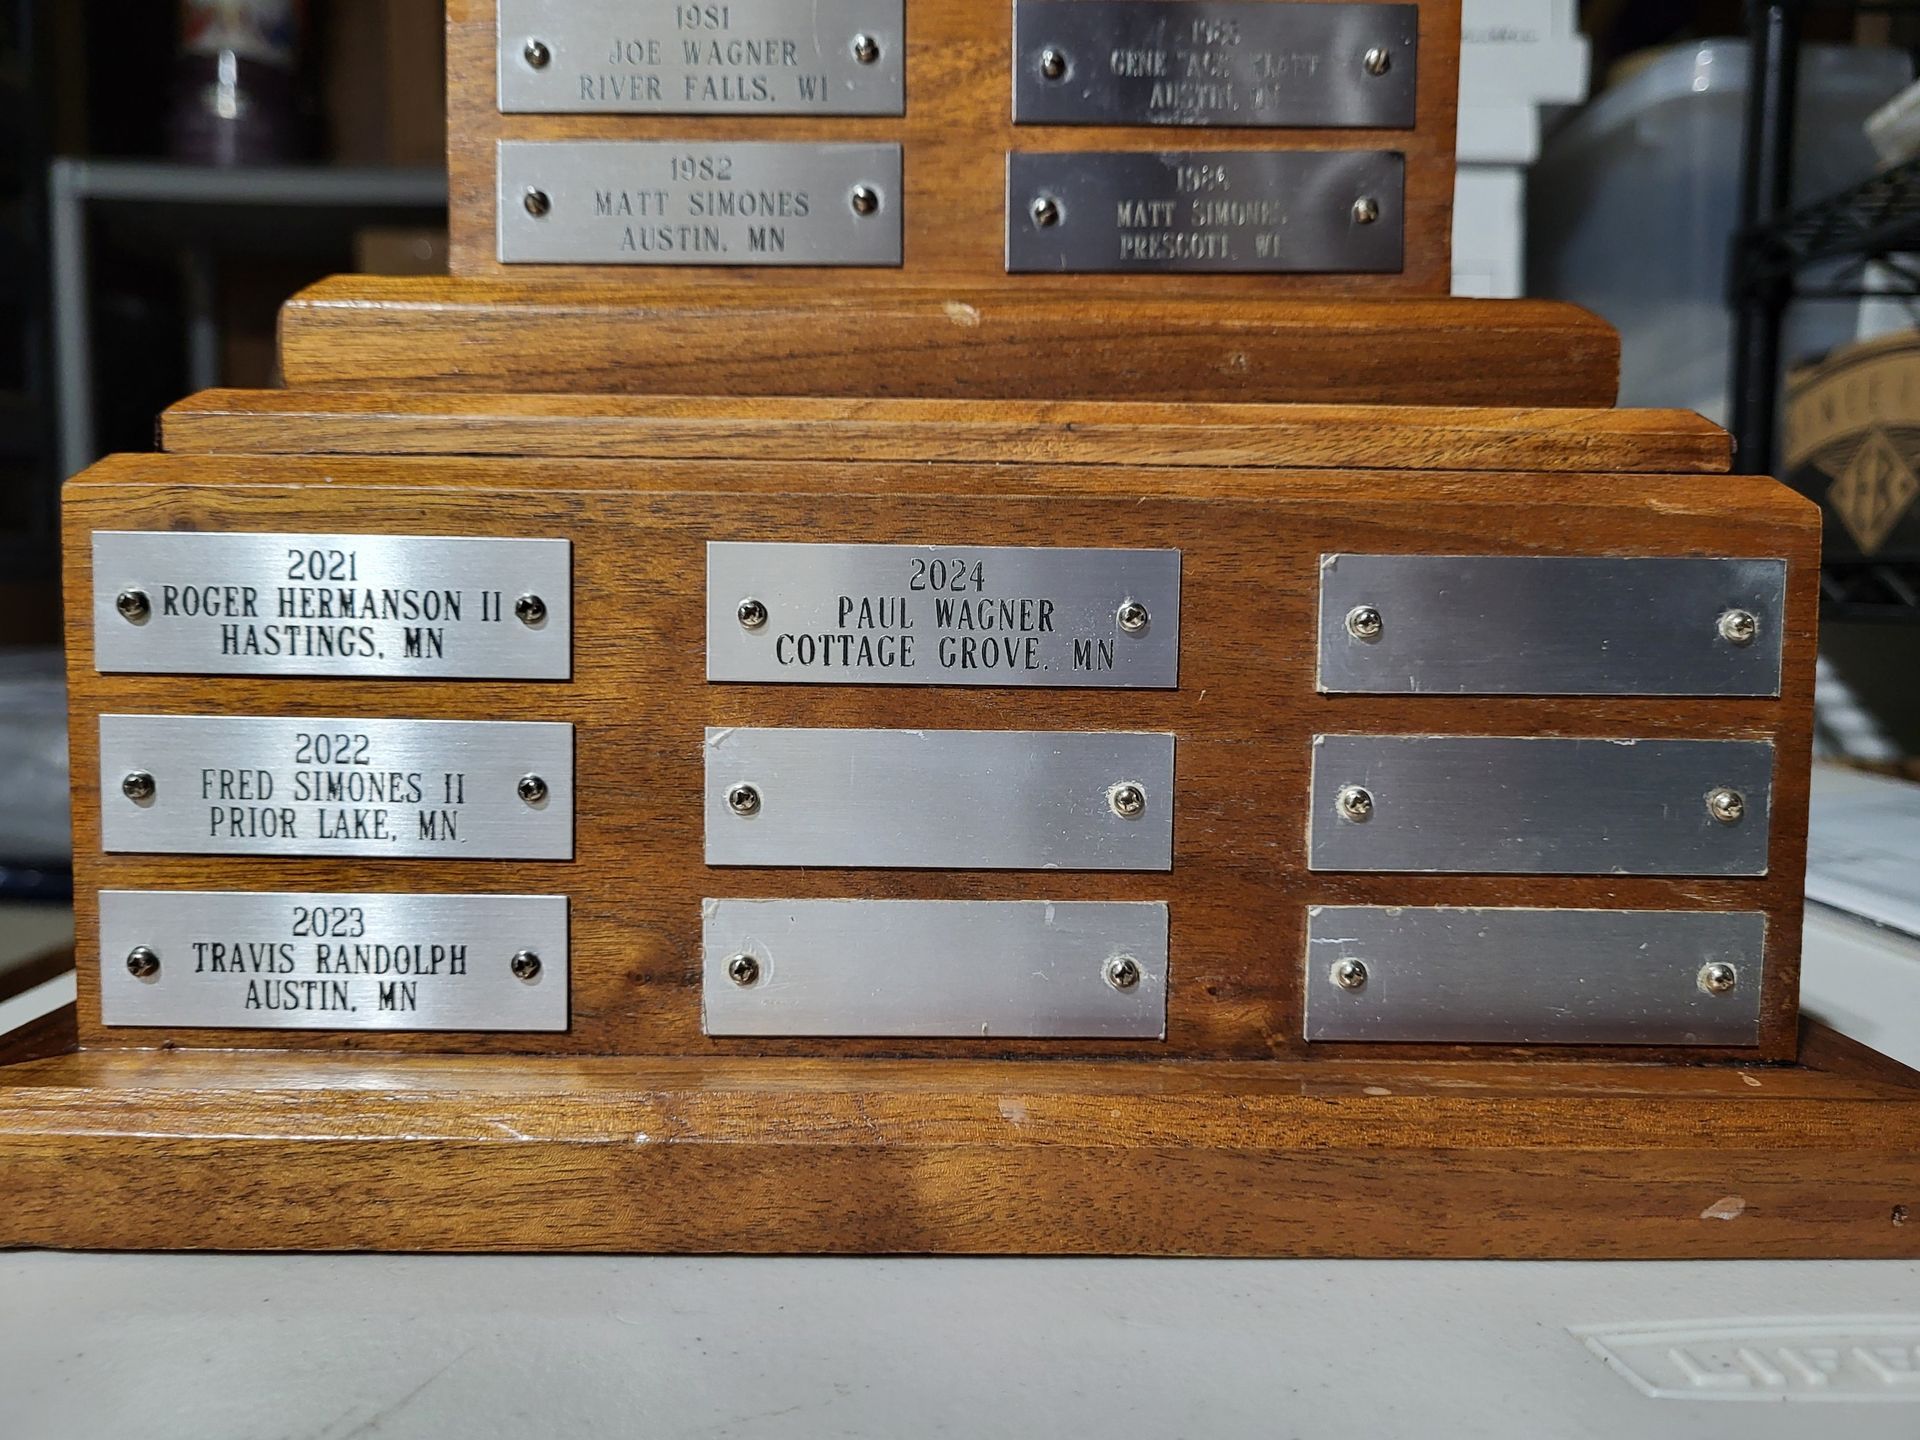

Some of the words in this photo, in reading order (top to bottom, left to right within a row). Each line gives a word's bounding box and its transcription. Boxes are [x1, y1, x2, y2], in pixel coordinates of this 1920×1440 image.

[676, 5, 729, 30] 1981
[608, 39, 662, 65] JOE
[683, 39, 799, 66] WAGNER
[579, 74, 663, 101] RIVER
[797, 74, 829, 102] WI
[671, 156, 732, 182] 1982
[595, 189, 669, 216] MATT
[689, 190, 810, 217] SIMONES
[1117, 200, 1176, 228] MATT
[748, 226, 786, 252] MN
[1255, 233, 1281, 259] WI
[288, 549, 358, 581] 2021
[910, 558, 985, 592] 2024
[162, 585, 258, 617] ROGER
[277, 587, 462, 621] HERMANSON
[481, 591, 502, 622] II
[838, 595, 914, 629] PAUL
[934, 597, 1055, 632] WAGNER
[220, 624, 385, 659] HASTINGS,
[403, 627, 444, 659] MN
[776, 633, 915, 667] COTTAGE
[1072, 637, 1115, 671] MN
[295, 733, 370, 765] 2022
[201, 769, 273, 800] FRED
[294, 771, 422, 803] SIMONES
[444, 773, 465, 804] II
[210, 806, 297, 838] PRIOR
[318, 808, 397, 841] LAKE,
[292, 906, 365, 937] 2023
[192, 942, 295, 973] TRAVIS
[316, 943, 468, 975] RANDOLPH
[378, 981, 418, 1011] MN
[1668, 1347, 1920, 1387] LIFE
